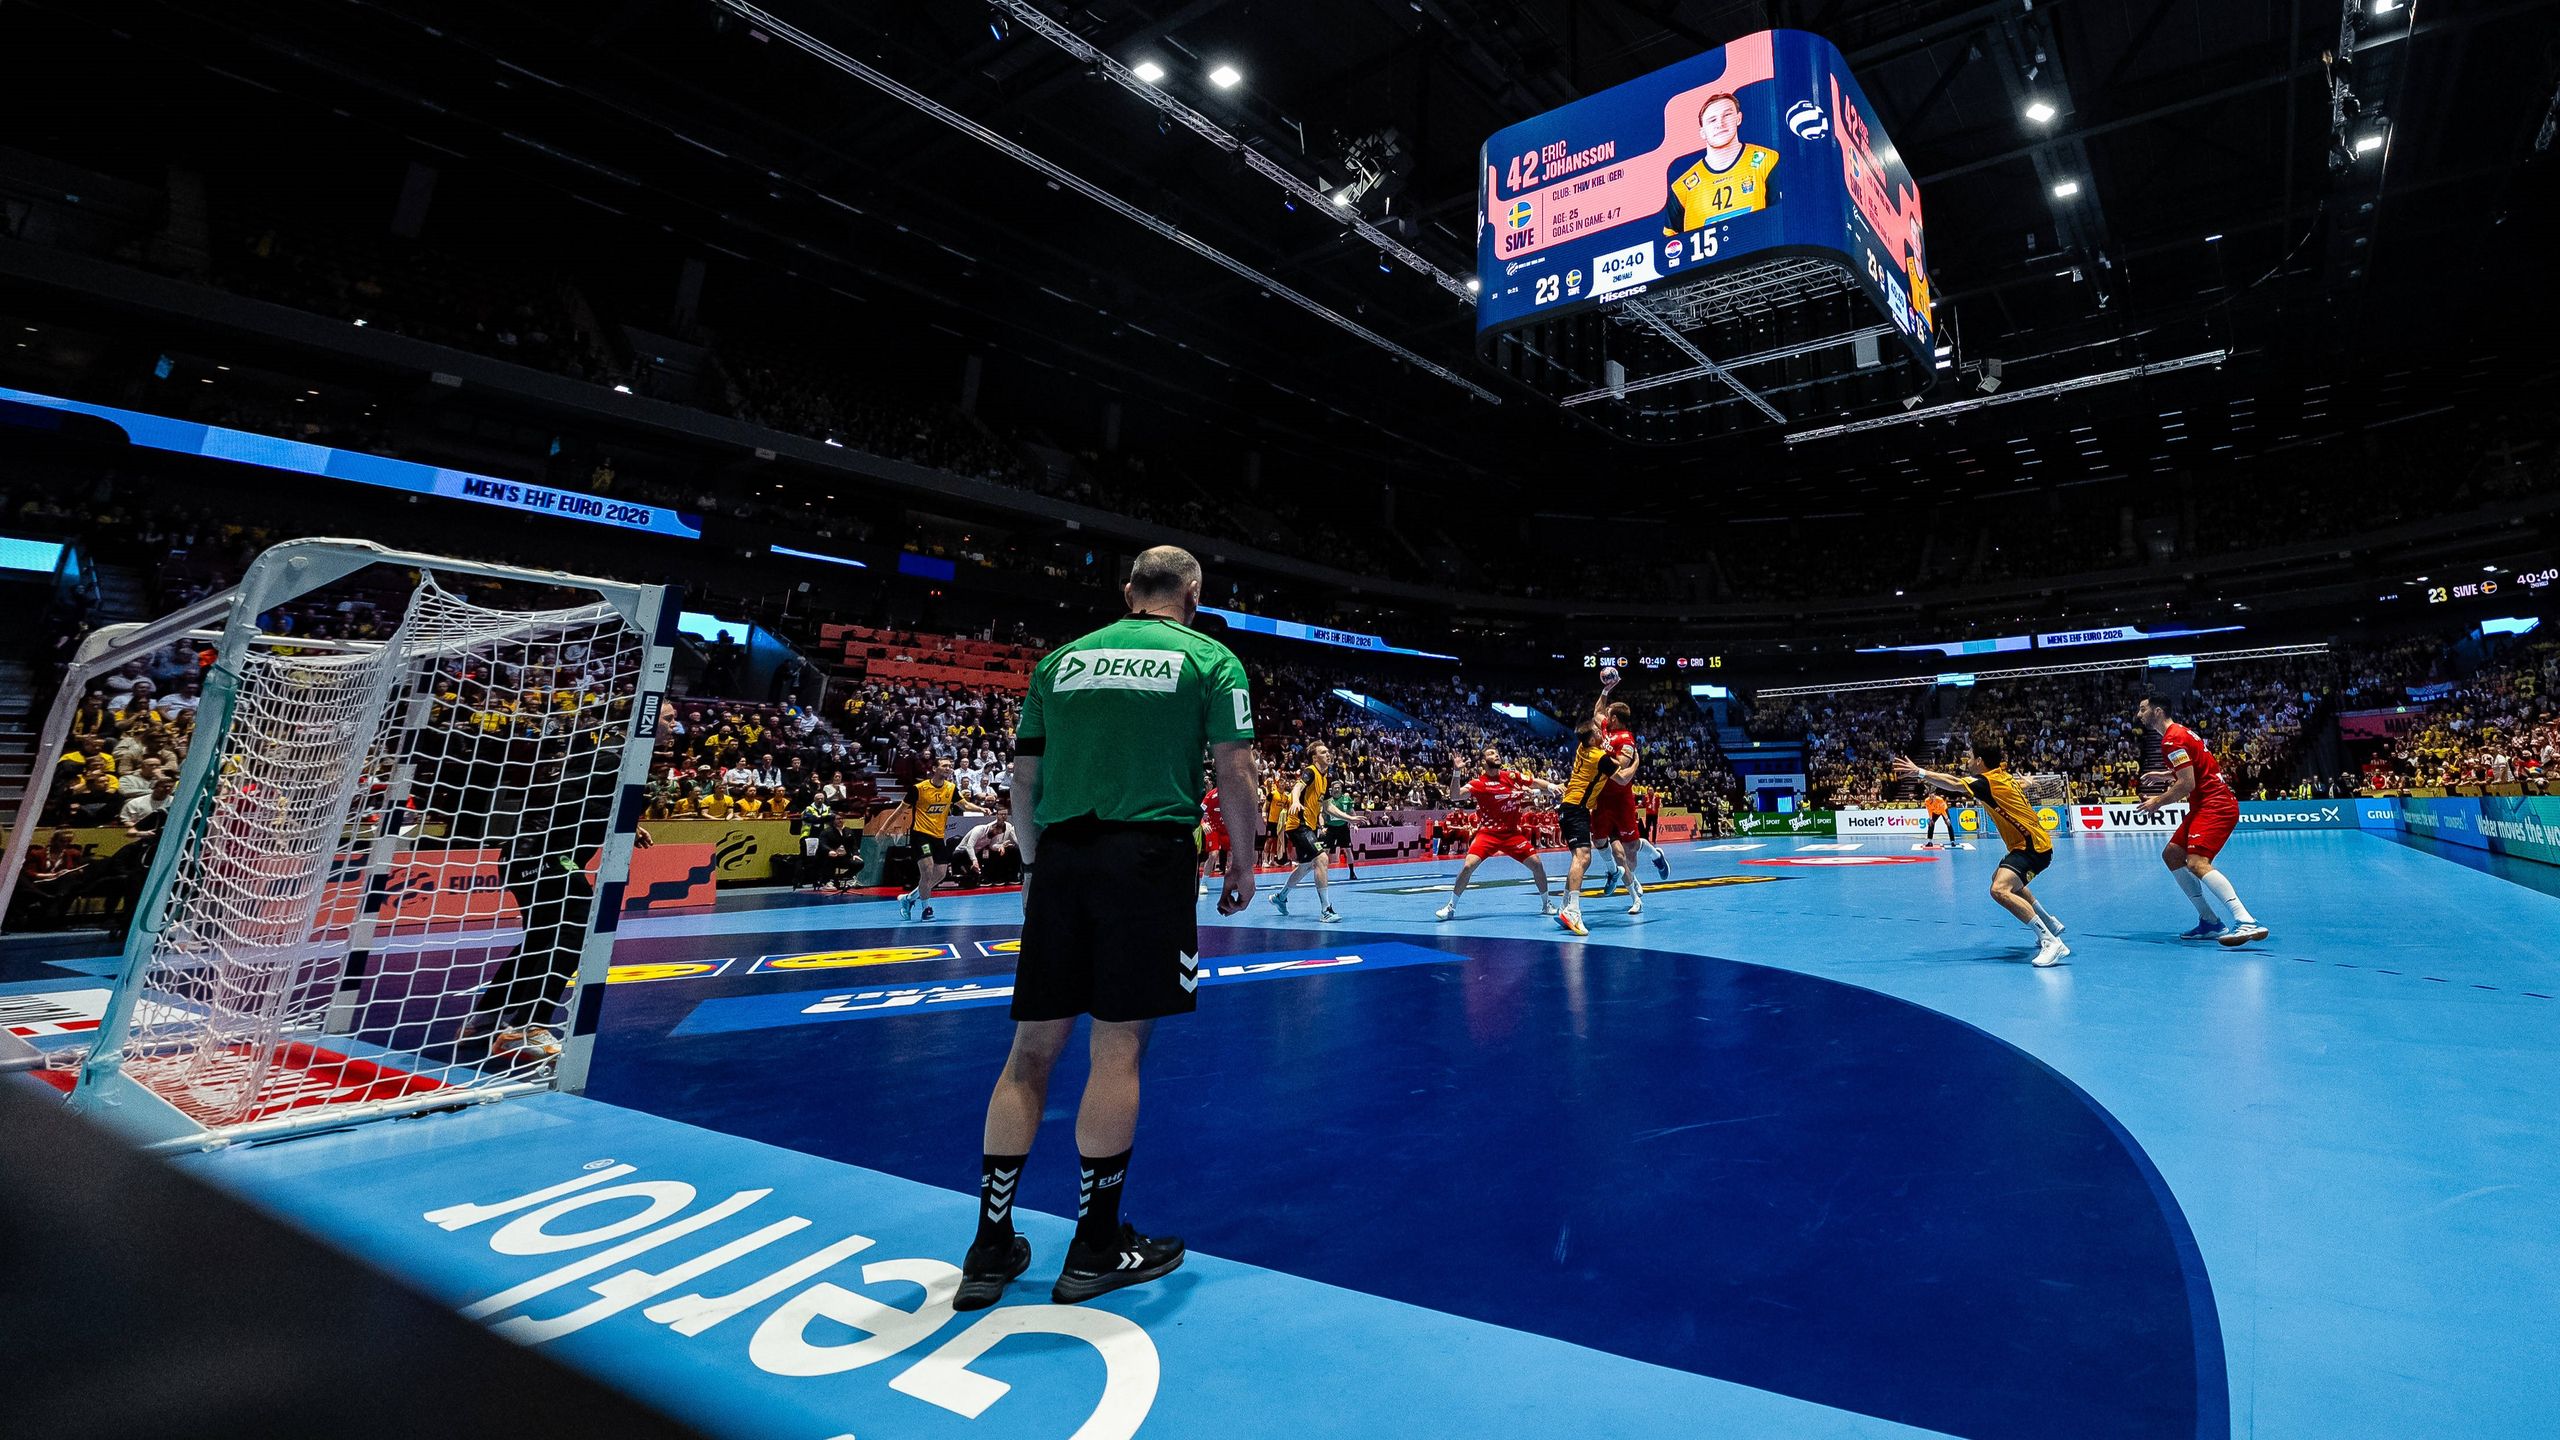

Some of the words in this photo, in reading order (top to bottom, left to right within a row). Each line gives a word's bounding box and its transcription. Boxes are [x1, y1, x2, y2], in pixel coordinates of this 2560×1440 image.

[1542, 140, 1567, 164] ERIC
[1542, 141, 1615, 181] JOHANSSON
[1507, 151, 1539, 192] 42
[1553, 186, 1571, 200] CLUB:
[1591, 175, 1606, 188] KIEL
[1607, 168, 1625, 182] (GER)
[1712, 185, 1733, 211] 42
[1553, 212, 1567, 225] AGE:
[1569, 208, 1579, 219] 25
[1553, 223, 1574, 238] GOALS
[1576, 220, 1583, 231] IN
[1584, 212, 1605, 227] GAME:
[1607, 207, 1621, 219] 4/7
[1506, 228, 1534, 252] SWE
[1690, 227, 1719, 262] 15
[1602, 252, 1644, 274] 40:40
[1535, 274, 1560, 306] 23
[1599, 284, 1647, 304] Hisense
[462, 477, 521, 503] MEN'S
[524, 489, 557, 509] EHF
[557, 495, 603, 517] EURO
[605, 504, 650, 525] 2026
[2428, 587, 2448, 604] 23
[2453, 583, 2478, 598] SWE
[2517, 568, 2559, 585] 40:40
[1330, 632, 1341, 643] EHF
[1341, 634, 1355, 645] EURO
[1356, 636, 1372, 647] 2026
[2069, 634, 2082, 643] EHF
[2083, 632, 2102, 641] EURO
[2103, 630, 2123, 639] 2026
[1093, 658, 1172, 680] DEKRA
[1583, 655, 1596, 668] 23
[1600, 656, 1616, 667] SWE
[1639, 656, 1666, 665] 40:40
[1690, 658, 1704, 667] CRO
[1709, 656, 1722, 668] 15
[640, 695, 659, 735] BENZ
[1848, 816, 1884, 827] Hotel?
[2239, 812, 2320, 824] RUNDFOS
[2475, 814, 2498, 837] Water
[2497, 821, 2526, 842] moves
[2524, 815, 2544, 844] the
[1370, 831, 1394, 845] MALMÖ
[1099, 1169, 1124, 1187] EHF
[423, 1163, 1160, 1440] Gerflor
